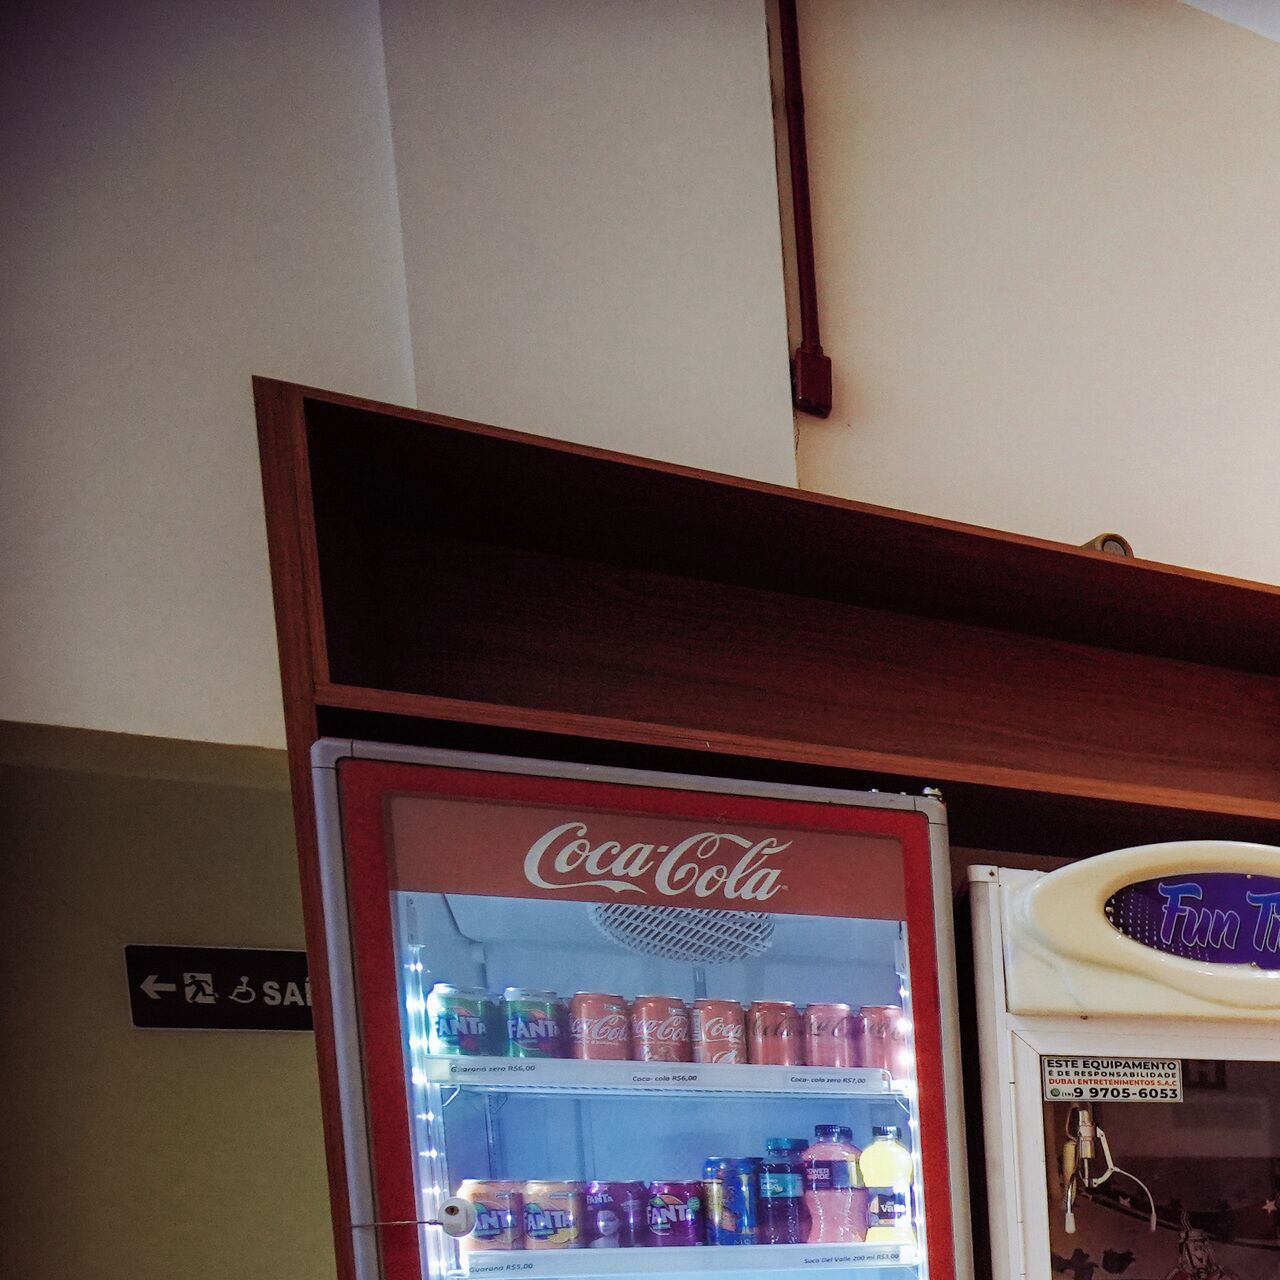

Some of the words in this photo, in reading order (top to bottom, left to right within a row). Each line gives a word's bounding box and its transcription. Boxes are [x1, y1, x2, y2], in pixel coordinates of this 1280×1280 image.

[523, 821, 794, 901] Coca-Cola
[1157, 881, 1241, 950] Fun
[1047, 1059, 1079, 1069] ESTE
[1082, 1059, 1177, 1070] EQUIPAMENTO
[1074, 1070, 1177, 1079] RESPONSABILIDADE
[1089, 1087, 1178, 1099] 9705-6053
[586, 1193, 614, 1204] FANTA
